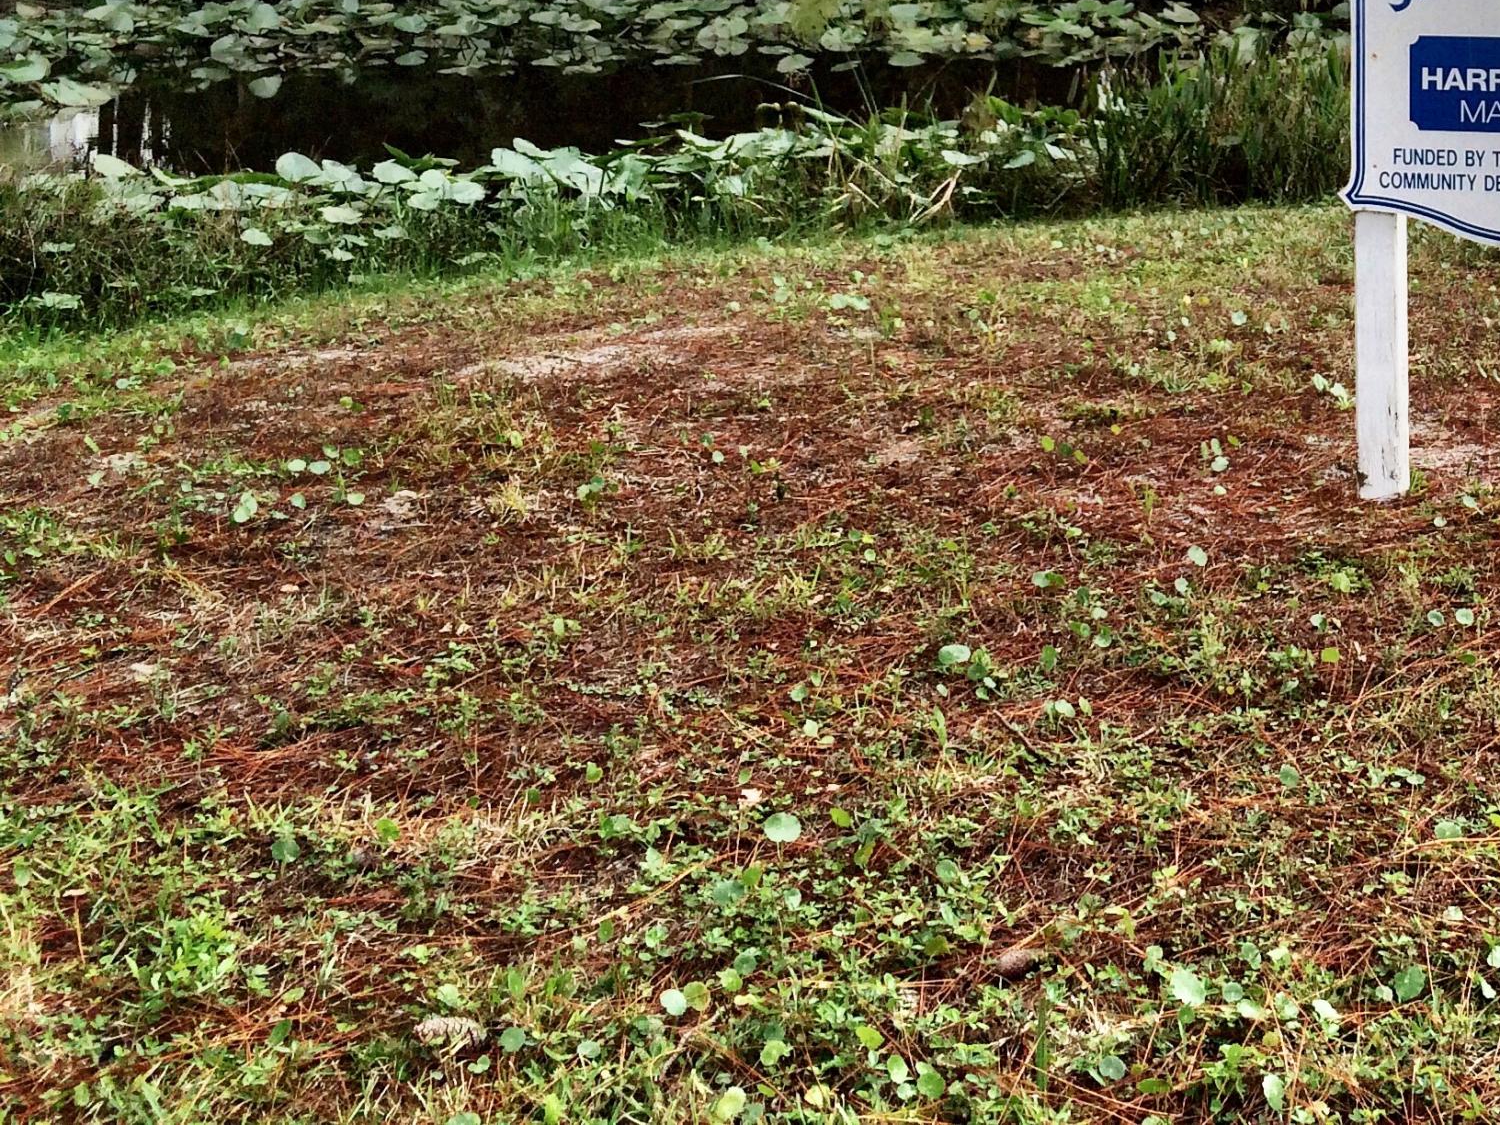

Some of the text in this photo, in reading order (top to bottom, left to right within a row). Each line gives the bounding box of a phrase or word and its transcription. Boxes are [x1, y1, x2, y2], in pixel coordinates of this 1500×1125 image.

[1393, 148, 1457, 166] FUNDED
[1465, 150, 1485, 167] BY
[1379, 171, 1477, 190] COMMUNITY
